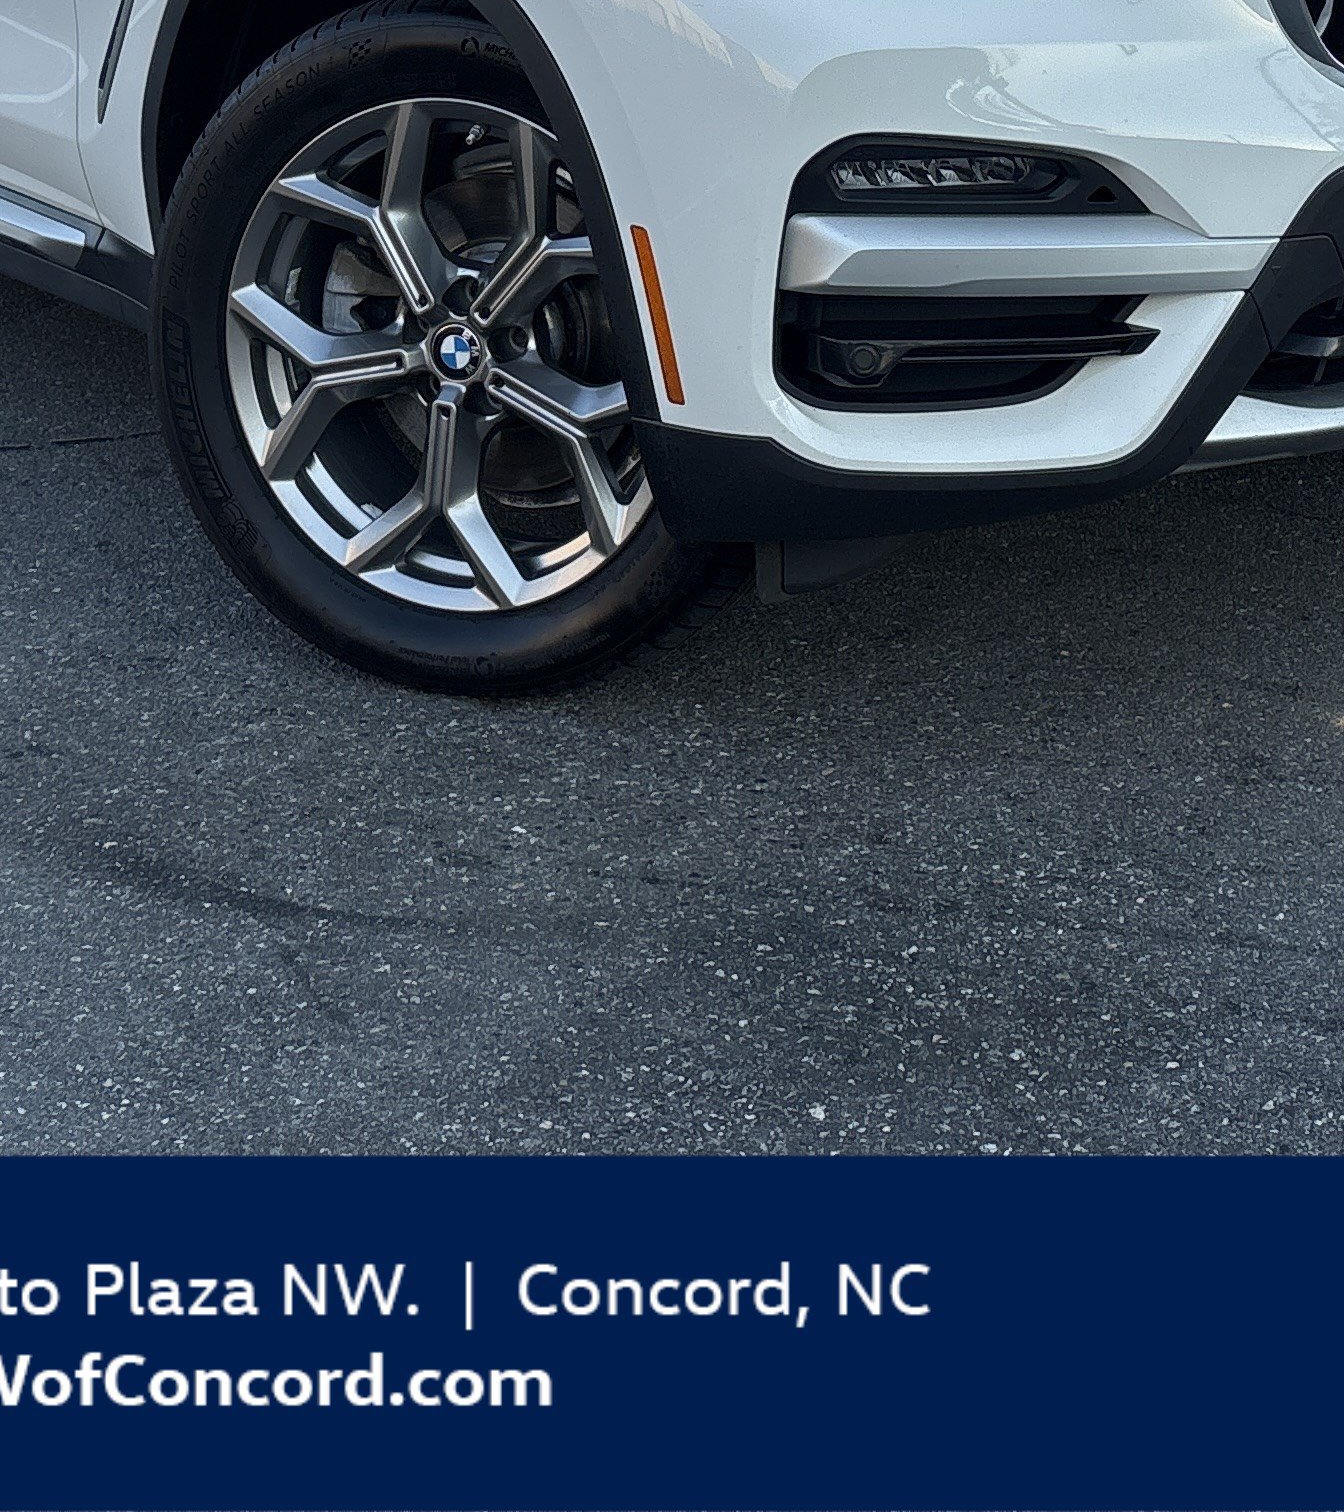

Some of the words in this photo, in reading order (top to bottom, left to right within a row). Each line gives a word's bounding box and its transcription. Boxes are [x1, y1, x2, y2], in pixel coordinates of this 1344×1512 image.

[168, 231, 189, 291] PILOT
[186, 156, 225, 226] SPORT
[224, 121, 250, 154] ALL
[253, 63, 321, 120] SEASON
[164, 319, 225, 499] MICHELIN
